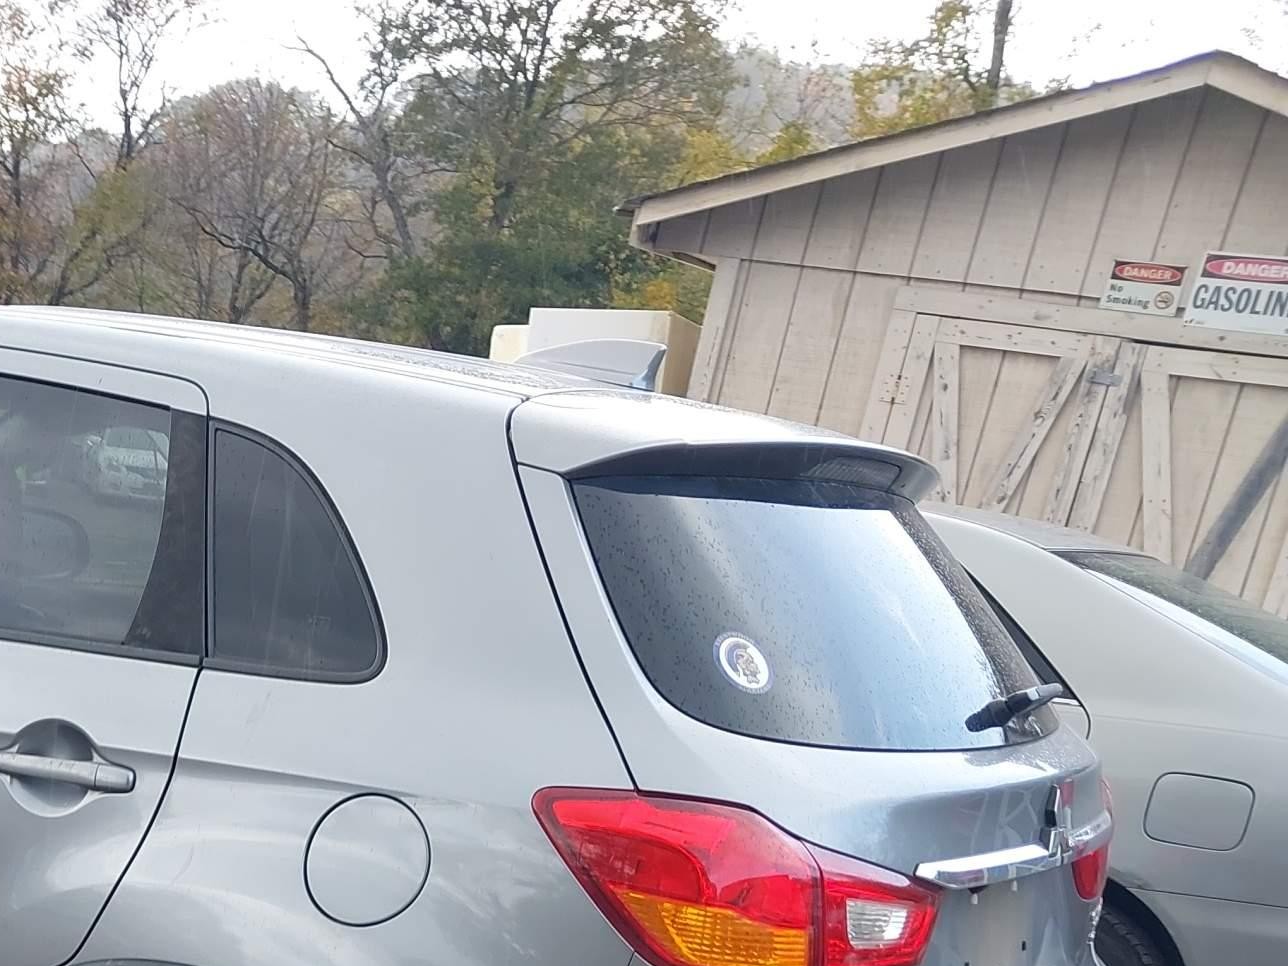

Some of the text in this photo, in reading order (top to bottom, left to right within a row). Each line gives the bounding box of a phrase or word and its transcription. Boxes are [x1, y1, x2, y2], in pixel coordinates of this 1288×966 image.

[1122, 266, 1172, 281] DANGER
[1110, 283, 1124, 293] No
[1105, 294, 1151, 310] Smoking
[1192, 283, 1288, 318] GASOLIN
